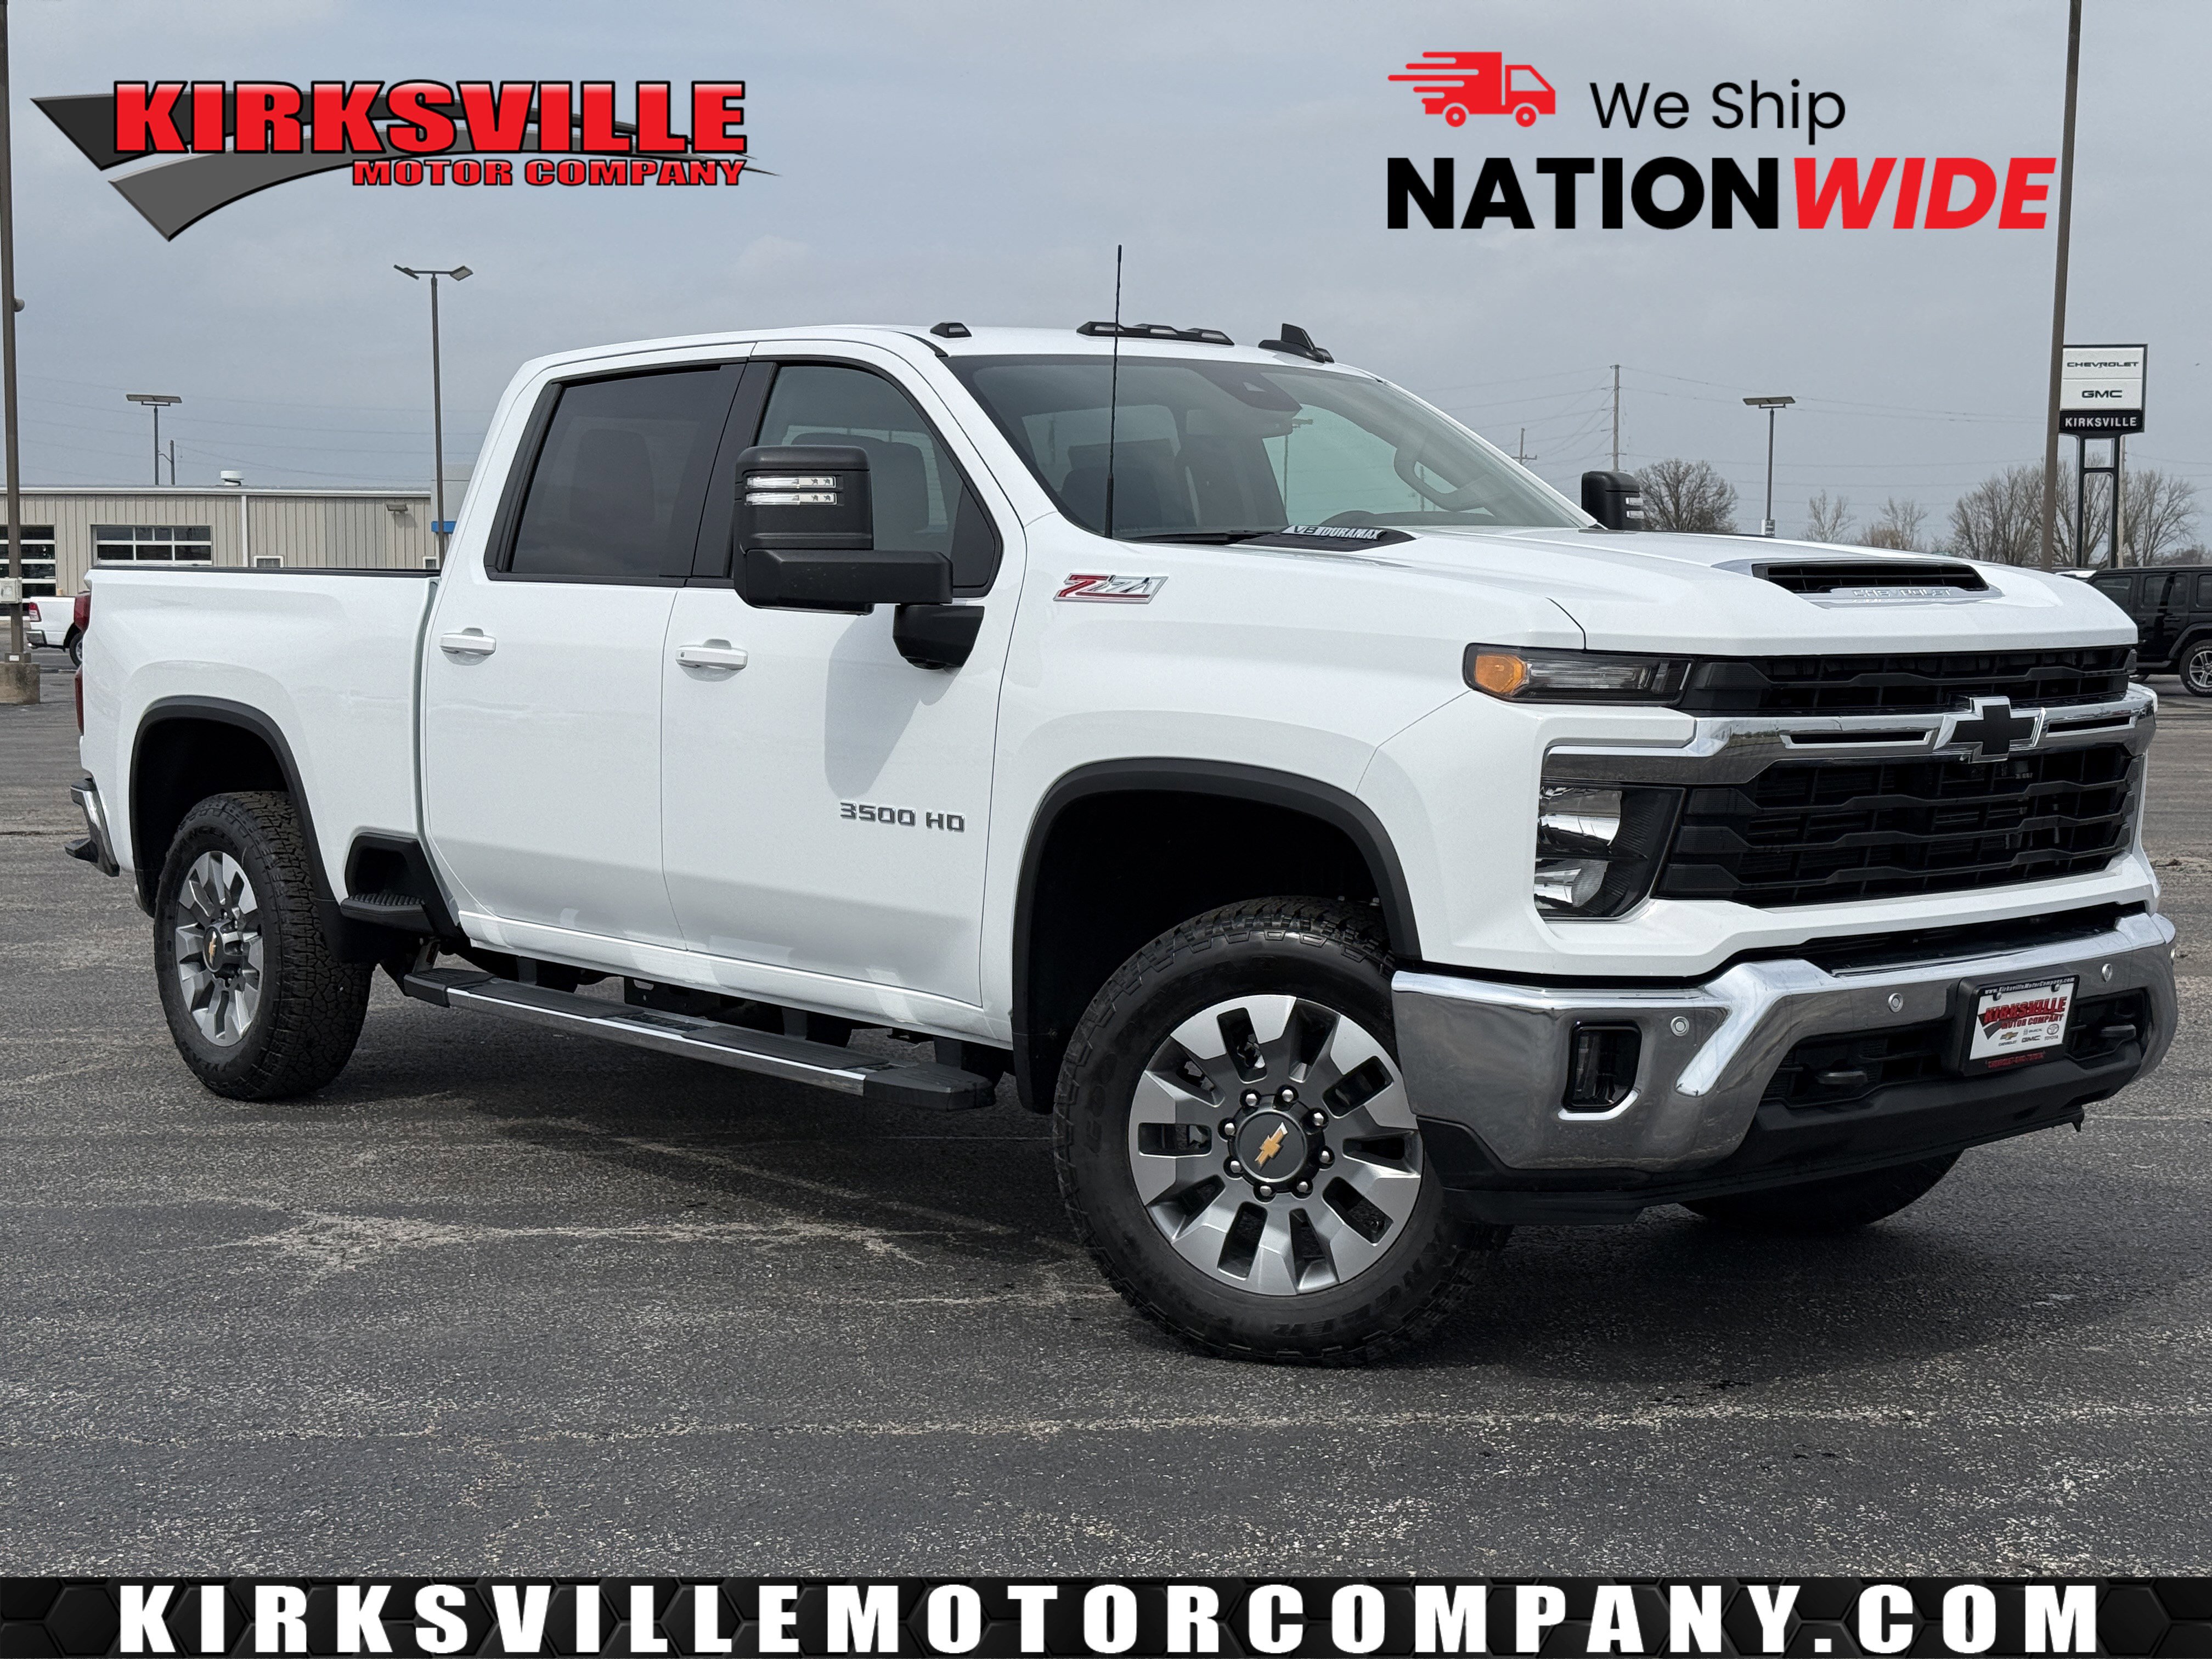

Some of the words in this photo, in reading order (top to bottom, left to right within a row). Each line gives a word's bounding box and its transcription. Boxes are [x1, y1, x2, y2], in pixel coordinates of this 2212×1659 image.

[2064, 416, 2137, 427] KIRKSVILLE
[1320, 527, 1384, 540] DURAMAX
[840, 800, 916, 827] 3500
[926, 810, 965, 833] HD
[1984, 996, 2068, 1024] KIRKSVILLE
